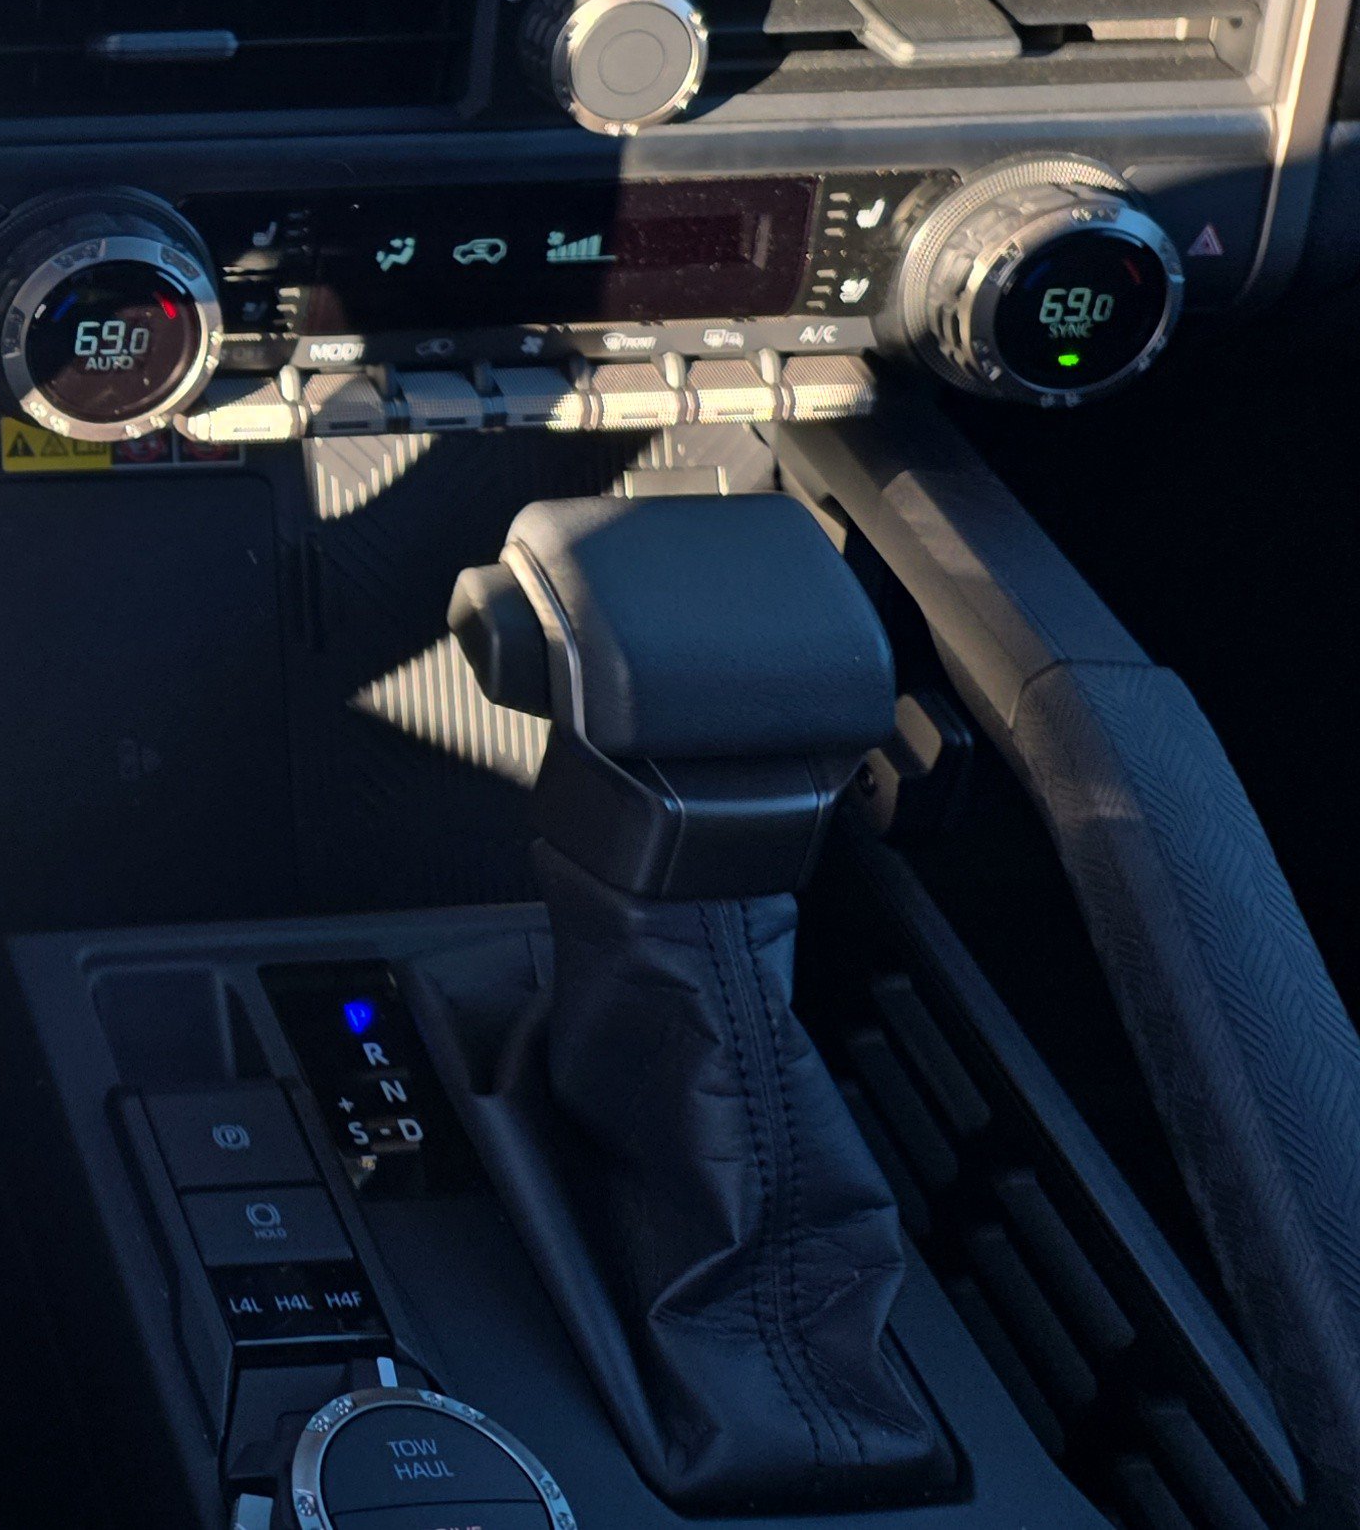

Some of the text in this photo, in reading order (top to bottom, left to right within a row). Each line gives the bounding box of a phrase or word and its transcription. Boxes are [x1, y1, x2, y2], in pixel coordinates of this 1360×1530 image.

[75, 320, 149, 356] 69.0
[799, 325, 839, 345] A/C
[85, 356, 134, 370] AUTO
[363, 1043, 390, 1066] R
[380, 1080, 407, 1103] N
[230, 1291, 361, 1313] L4L H4L H4F
[387, 1439, 437, 1458] TOW
[394, 1460, 455, 1480] HAUL
